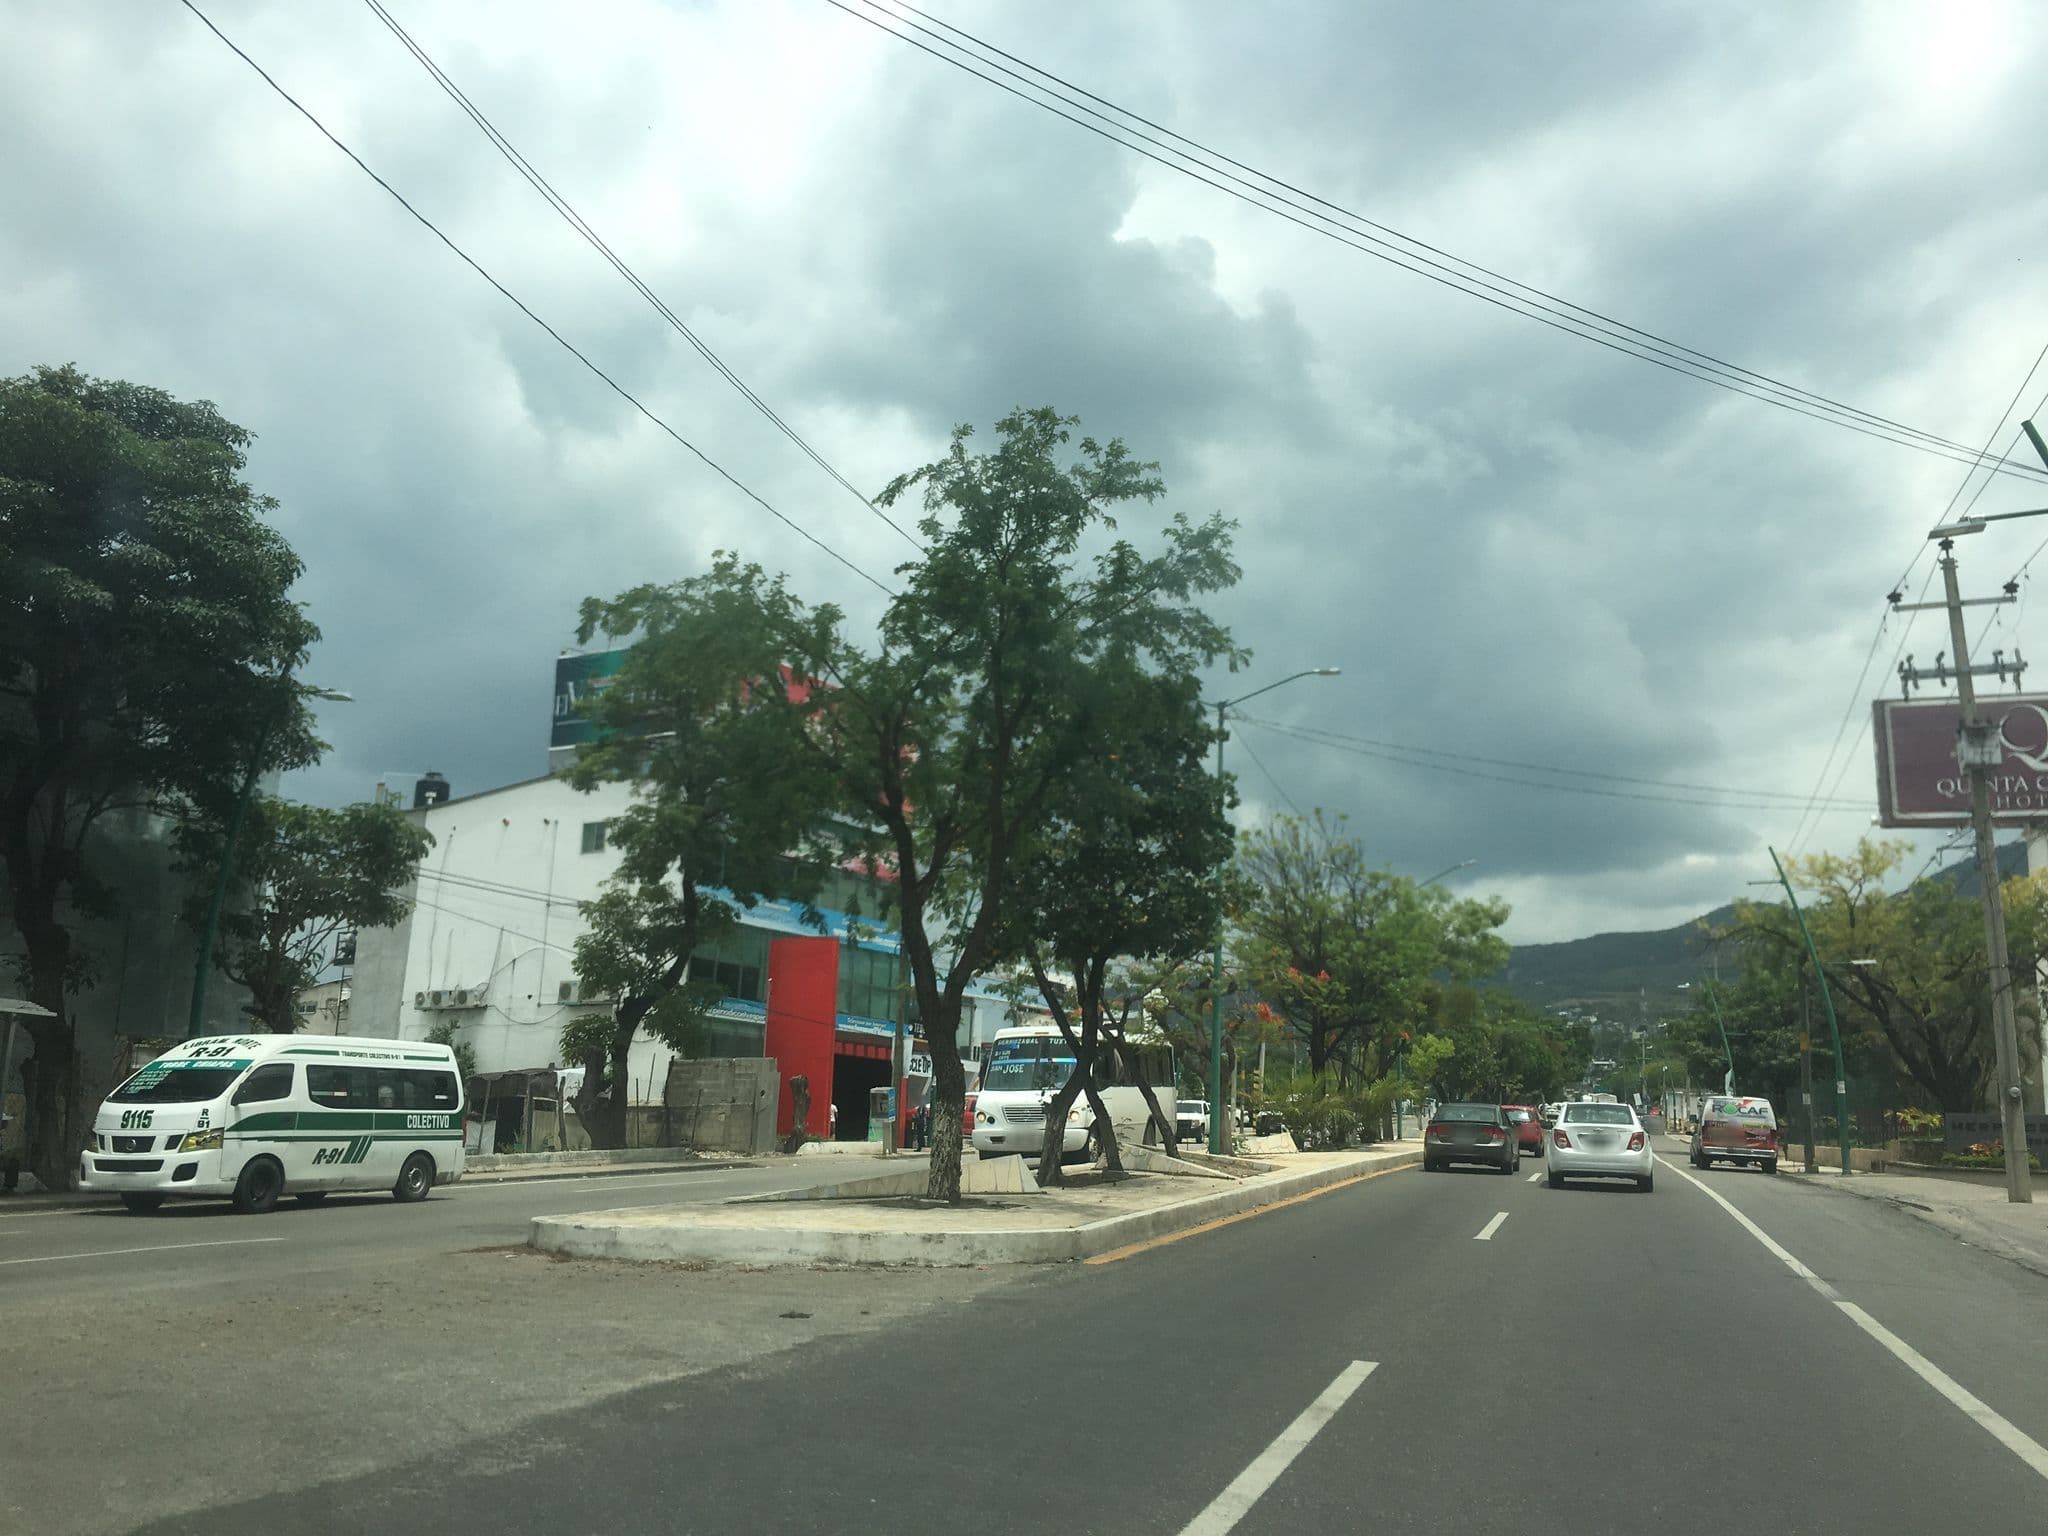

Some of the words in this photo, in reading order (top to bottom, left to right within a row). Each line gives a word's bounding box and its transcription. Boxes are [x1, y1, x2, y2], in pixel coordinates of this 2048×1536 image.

[1936, 776, 2029, 798] QUNTA
[188, 1047, 236, 1057] R-91
[1002, 1063, 1025, 1074] JOSE
[121, 1110, 154, 1129] 9115
[201, 1108, 209, 1117] R
[406, 1114, 450, 1129] COLECTIVO
[312, 1148, 345, 1165] R-91
